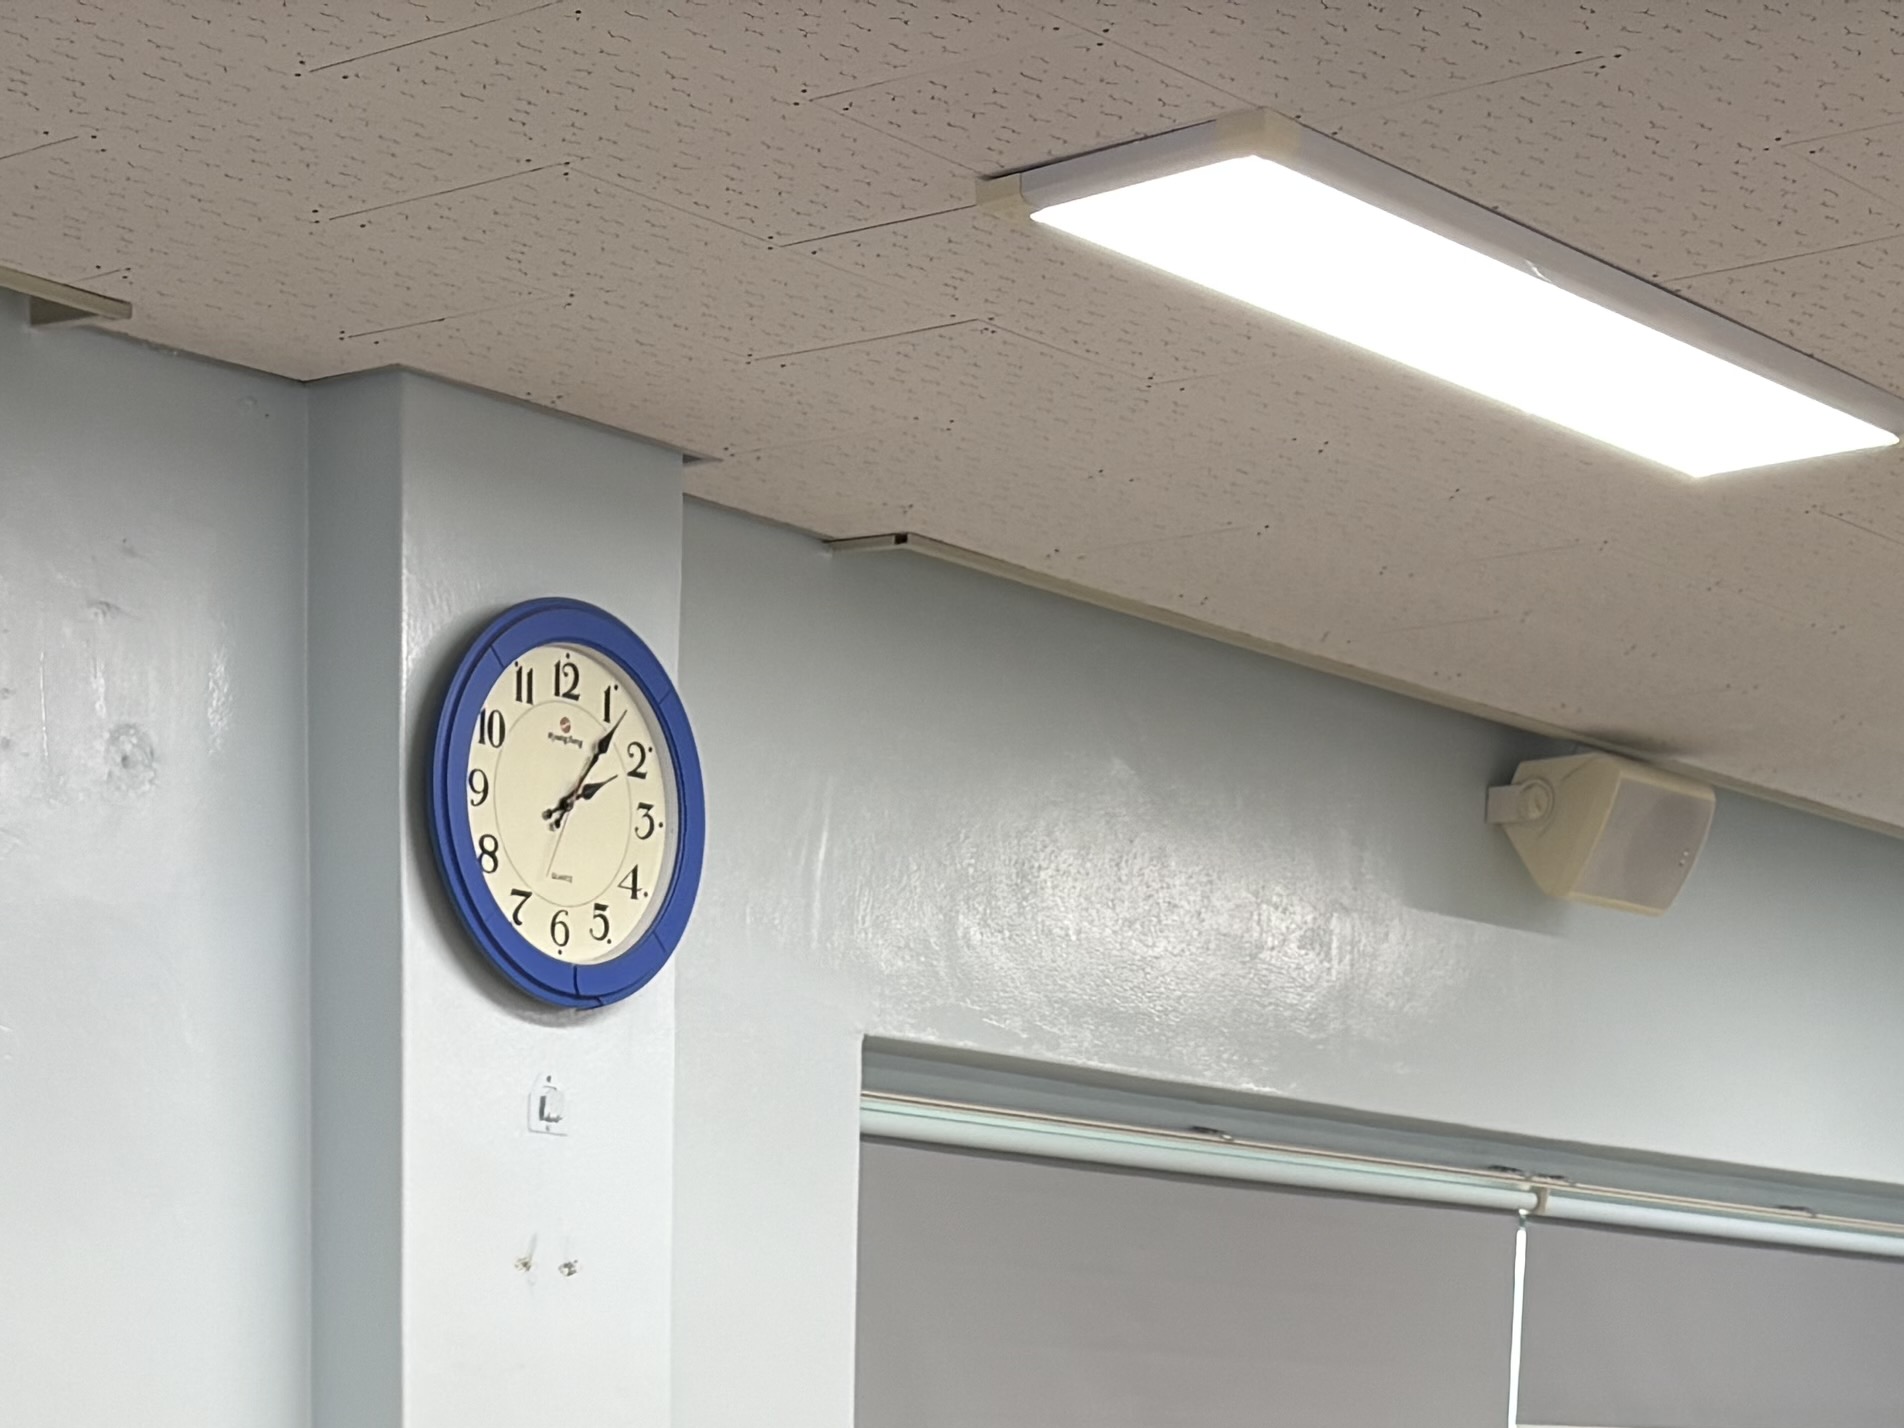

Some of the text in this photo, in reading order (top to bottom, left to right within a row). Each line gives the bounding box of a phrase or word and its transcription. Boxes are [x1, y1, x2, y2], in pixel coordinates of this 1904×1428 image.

[515, 665, 534, 705] 11
[554, 660, 580, 701] 12
[603, 686, 612, 723] 1
[478, 708, 506, 749] 10
[626, 741, 647, 779] 2
[468, 768, 489, 806] 9
[634, 802, 655, 840] 3
[479, 834, 500, 873] 8
[617, 864, 640, 900] 4
[510, 888, 533, 926] 7
[589, 903, 610, 941] 5
[550, 909, 570, 947] 6
